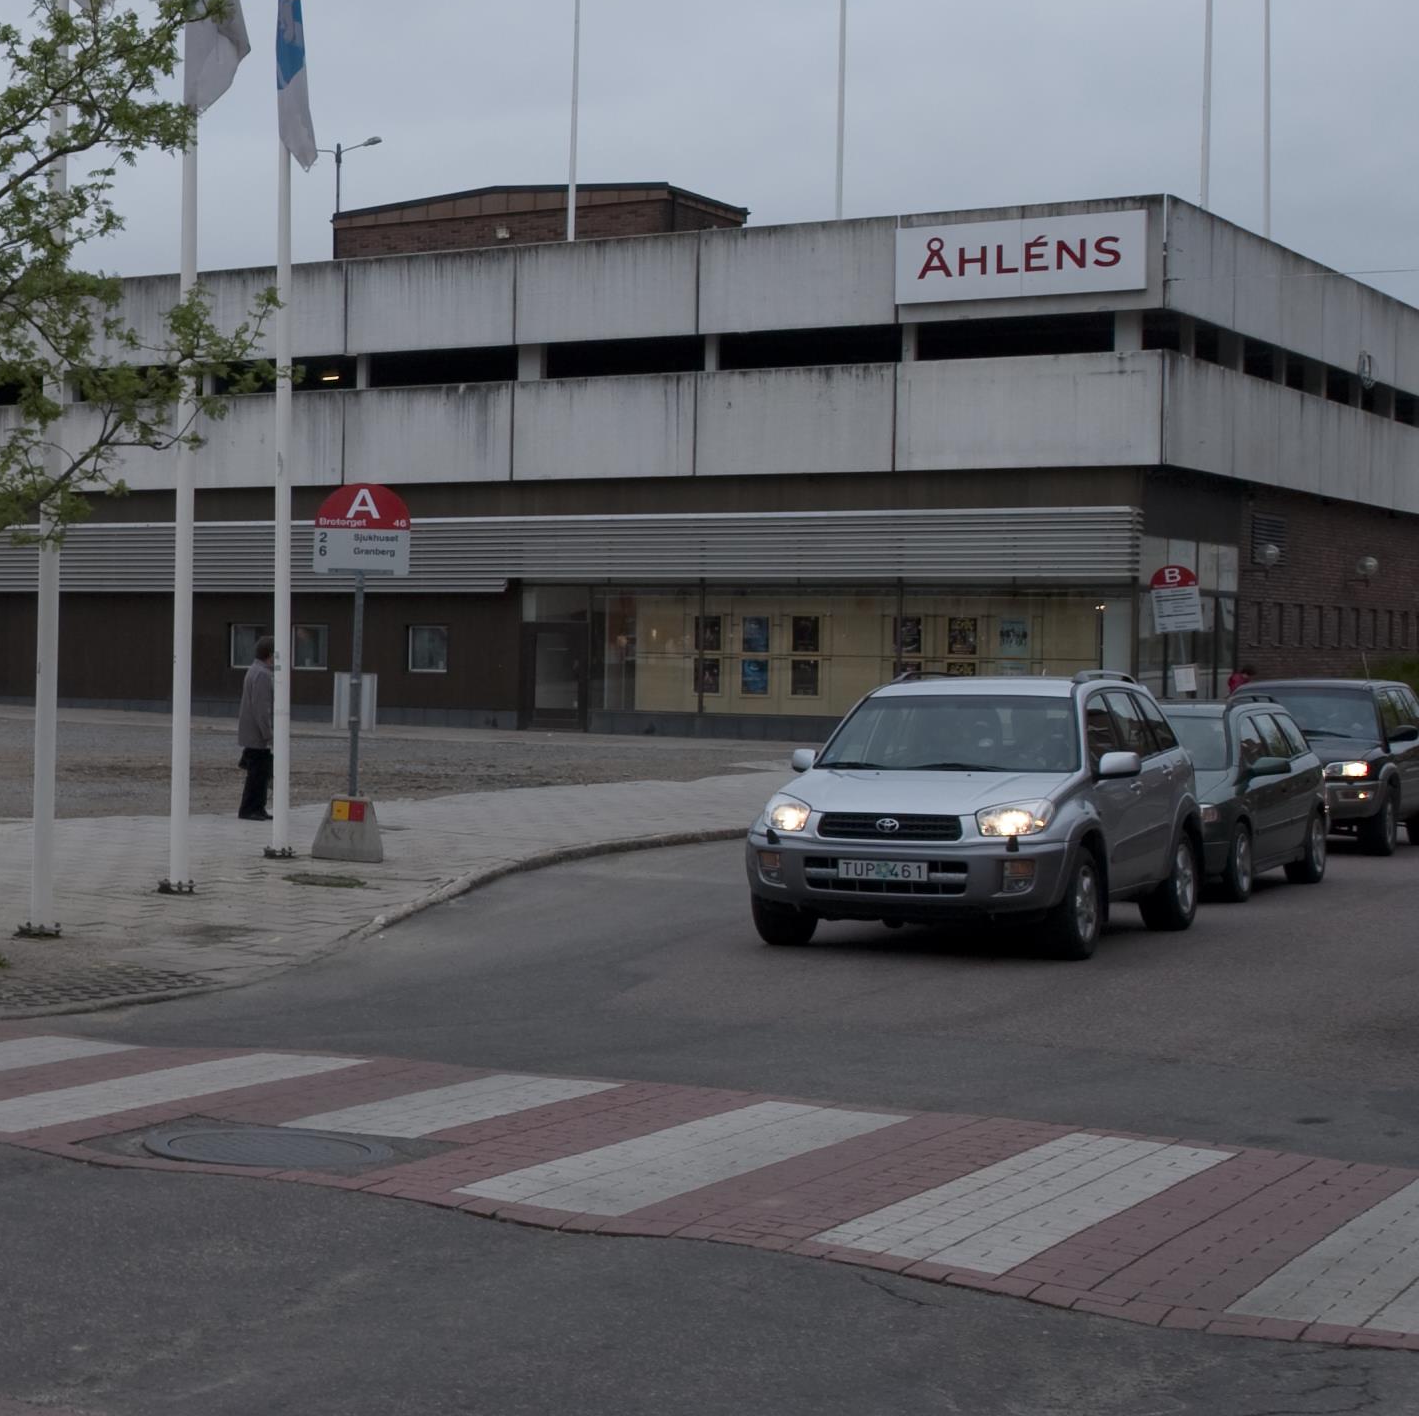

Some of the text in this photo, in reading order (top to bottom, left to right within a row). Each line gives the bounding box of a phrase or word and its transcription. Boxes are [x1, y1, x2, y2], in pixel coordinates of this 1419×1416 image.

[917, 235, 1121, 280] ÅHLÉNS
[346, 488, 381, 519] A
[319, 517, 367, 527] Brotorget
[319, 532, 399, 543] 2 Sjukhuset
[319, 546, 395, 558] 6 Granberg
[1164, 568, 1181, 583] B
[843, 862, 922, 879] TUP 461
